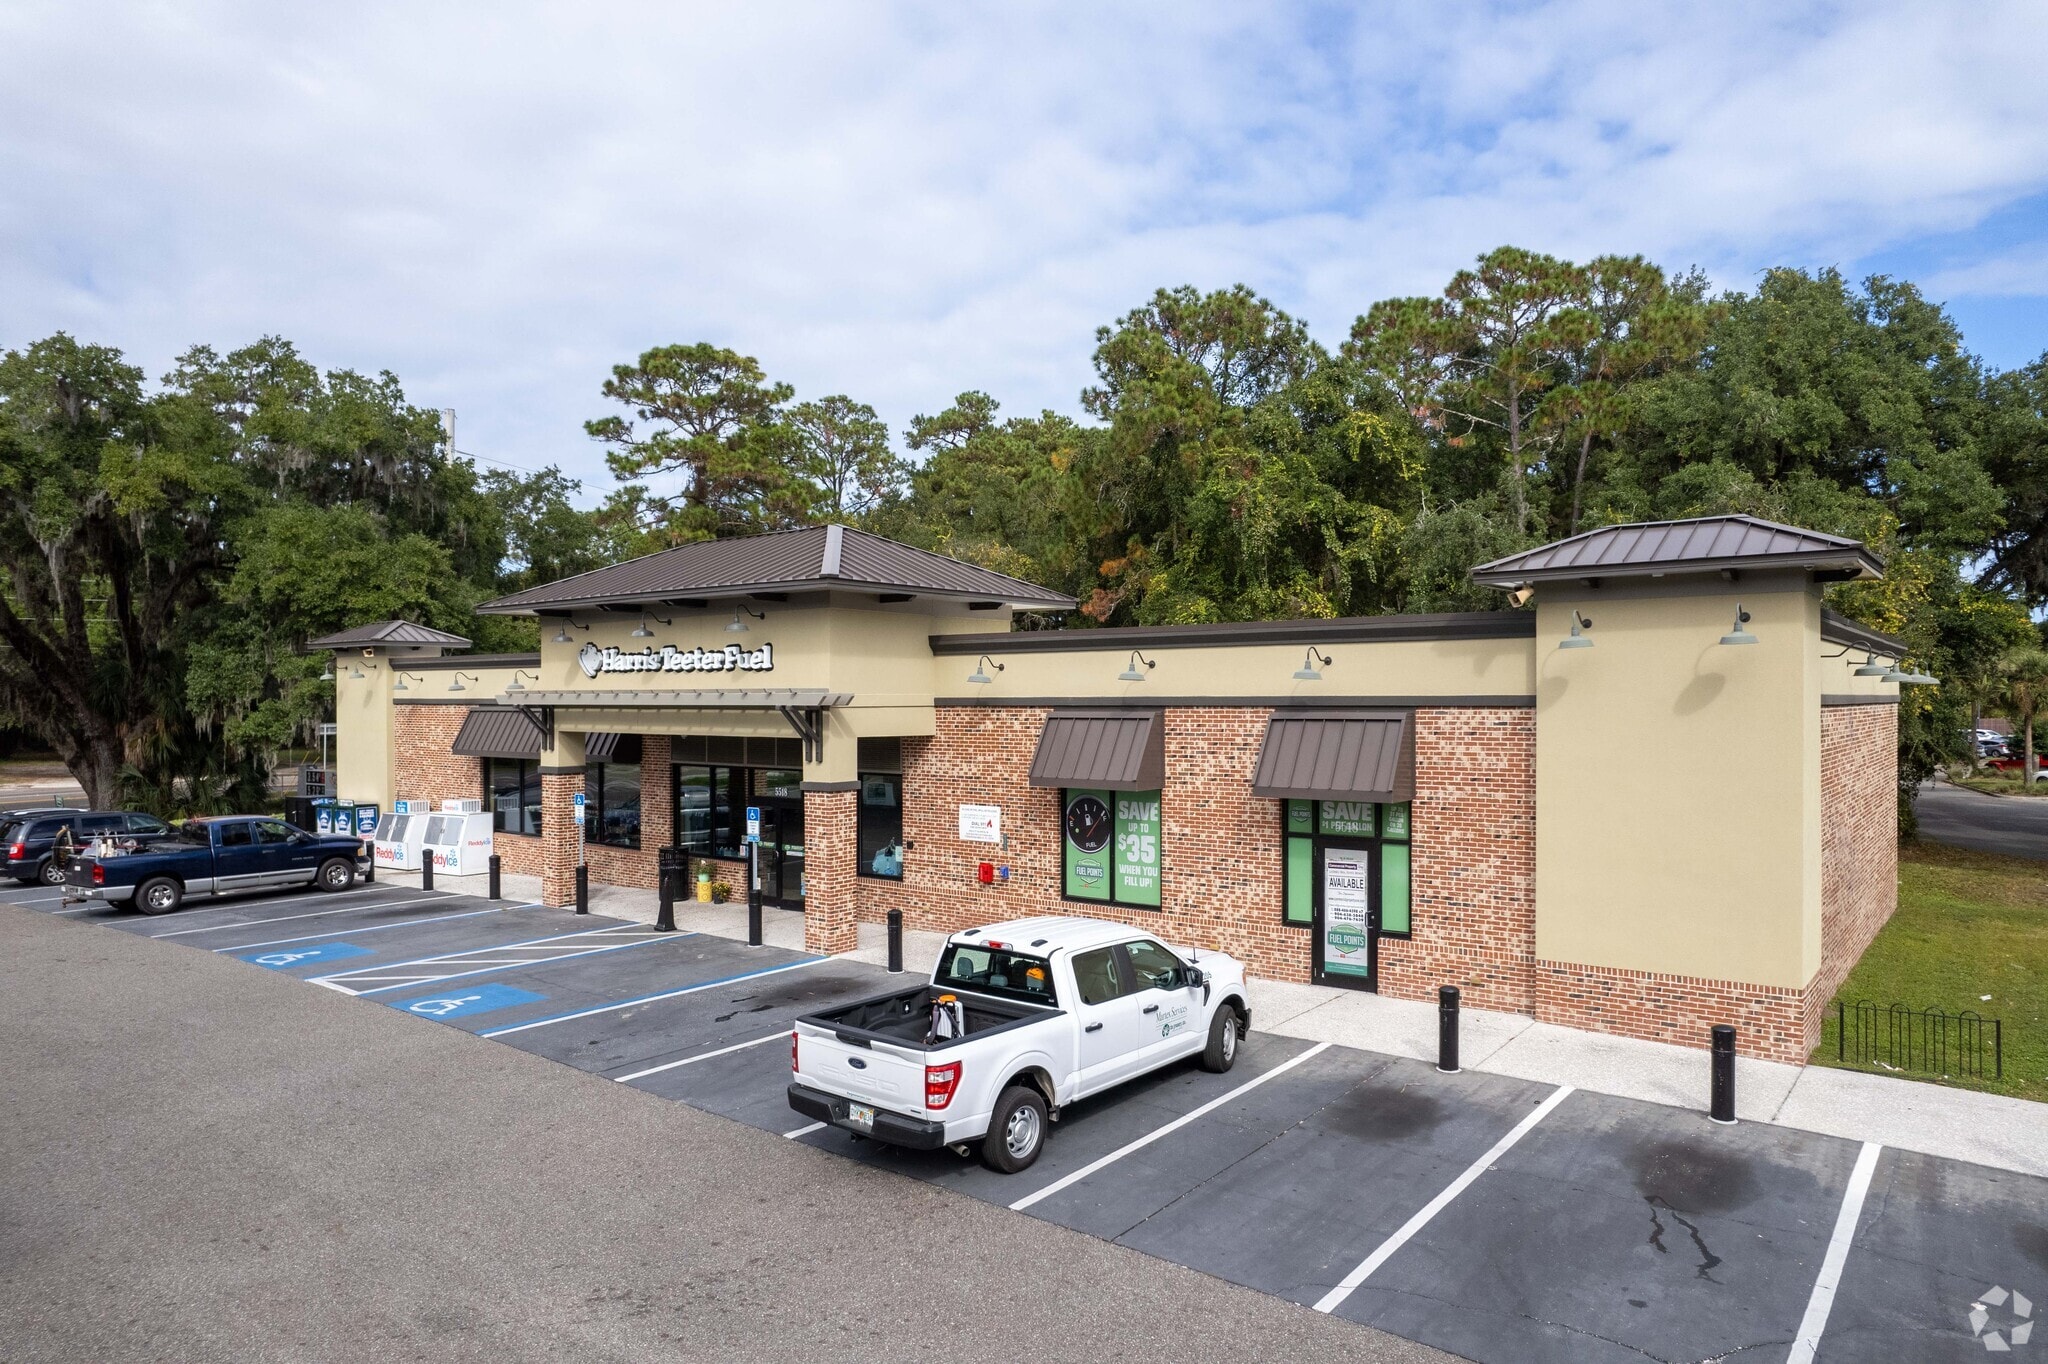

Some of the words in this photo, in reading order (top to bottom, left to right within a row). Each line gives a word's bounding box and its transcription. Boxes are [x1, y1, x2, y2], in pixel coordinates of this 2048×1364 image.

[600, 646, 661, 673] Harris
[660, 644, 724, 671] Teeter
[724, 642, 773, 671] Fuel
[775, 787, 788, 797] 5518
[1119, 801, 1159, 821] SAVE
[1322, 801, 1372, 821] SAVE
[1128, 823, 1138, 832] UP
[1140, 823, 1149, 833] TO
[1322, 821, 1329, 829] $1
[1118, 833, 1156, 863] $35
[433, 851, 458, 867] ddyIce
[1076, 866, 1087, 876] FUEL
[1087, 868, 1103, 877] POINTS
[1119, 864, 1141, 875] WHEN
[1143, 866, 1158, 877] YOU
[1124, 876, 1138, 886] FILL
[1139, 877, 1153, 888] UP!
[1329, 877, 1364, 889] AVAILABLE
[1330, 933, 1343, 944] FUEL
[1343, 935, 1365, 946] POINTS
